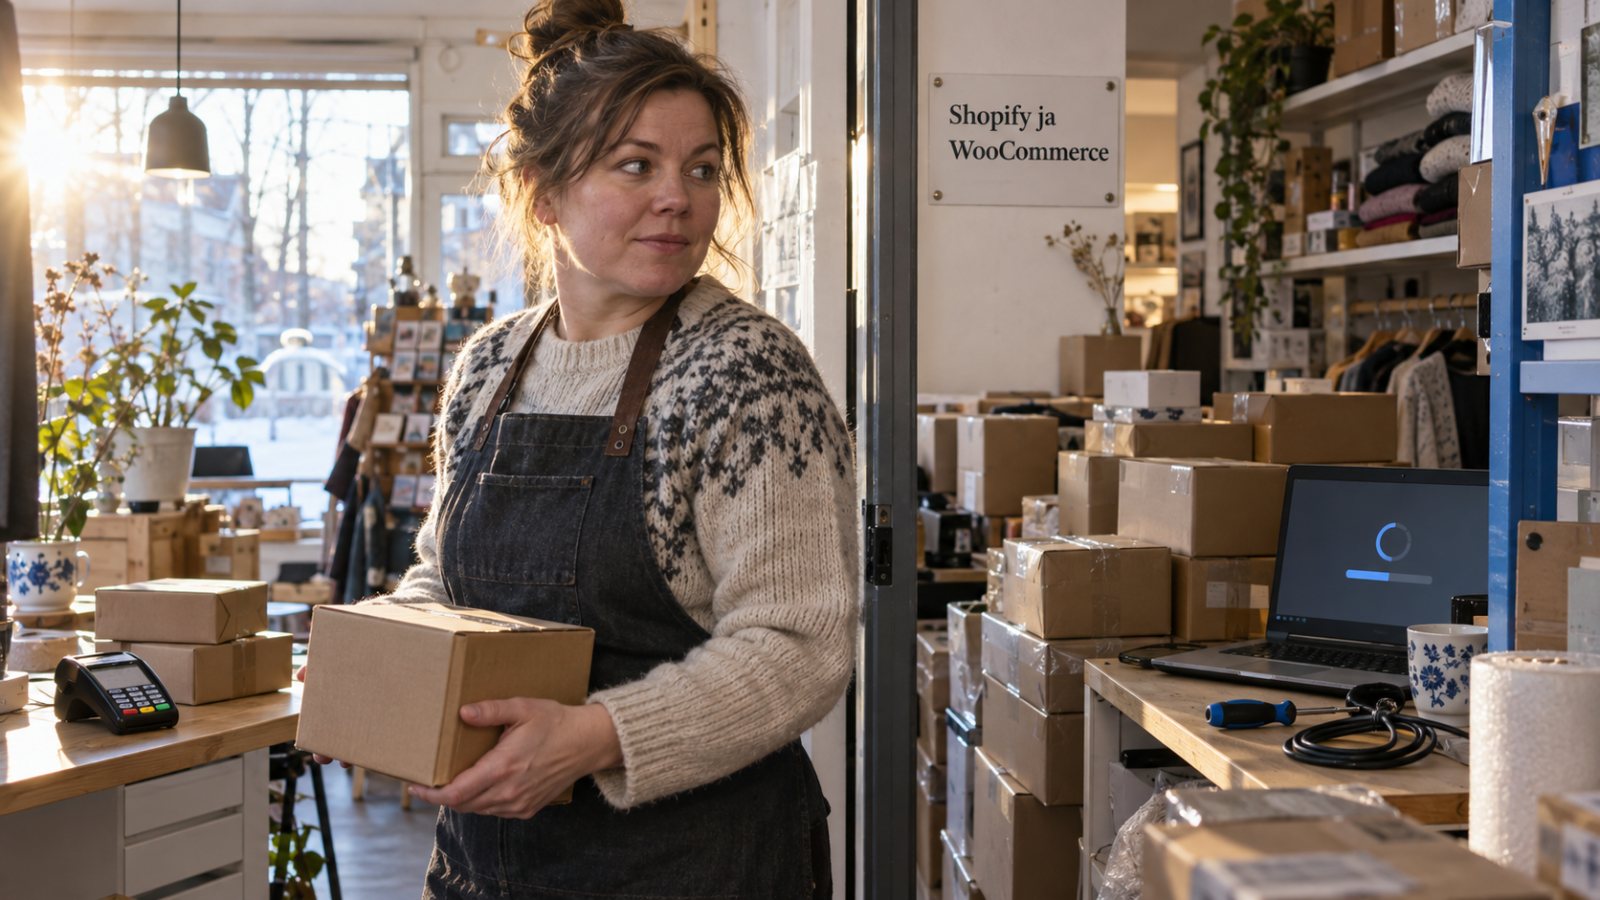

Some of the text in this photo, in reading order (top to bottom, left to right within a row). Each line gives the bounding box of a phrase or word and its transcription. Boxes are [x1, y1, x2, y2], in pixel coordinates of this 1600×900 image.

[949, 103, 1056, 132] Shopify ja
[949, 139, 1110, 162] WooCommerce
